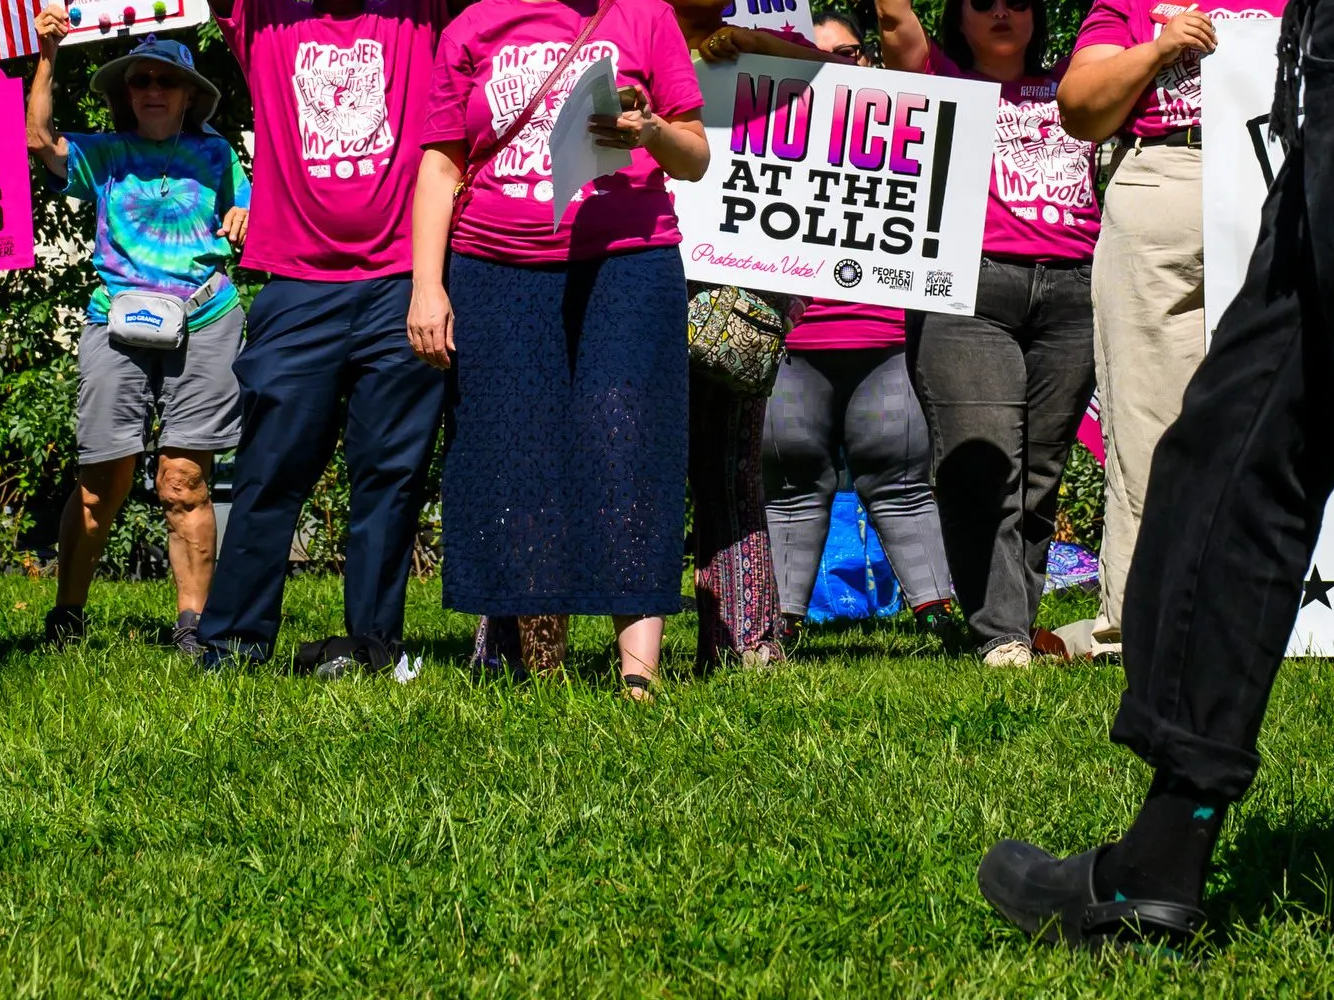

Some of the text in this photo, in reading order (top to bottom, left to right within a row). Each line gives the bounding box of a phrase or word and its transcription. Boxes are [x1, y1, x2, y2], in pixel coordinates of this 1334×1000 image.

[301, 43, 379, 70] MY POWER
[499, 48, 537, 72] MY
[304, 121, 333, 154] MY
[730, 72, 929, 176] NO ICE
[499, 146, 534, 170] MY
[722, 159, 918, 213] AT THE
[1001, 160, 1037, 196] MY
[691, 243, 823, 279] Protect our Vote!
[872, 267, 911, 279] PEOPLE'S
[877, 276, 910, 287] ACTION
[924, 284, 953, 297] HERE
